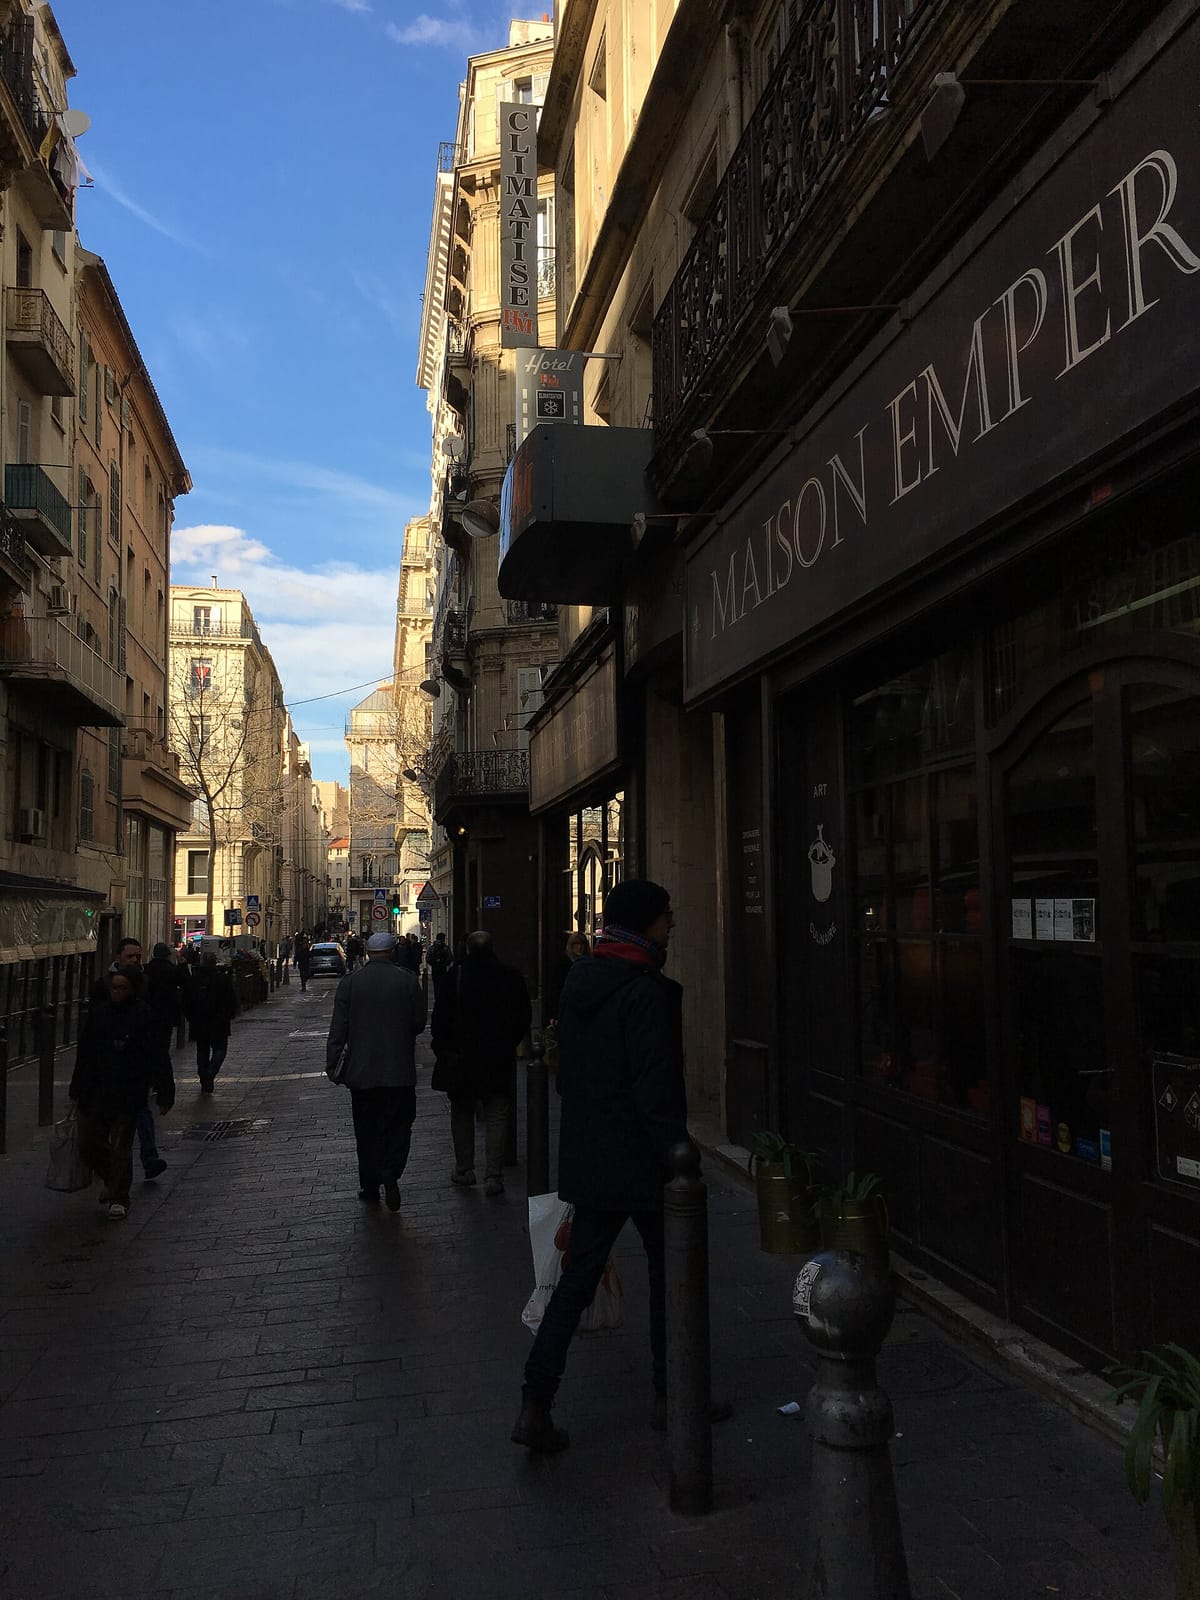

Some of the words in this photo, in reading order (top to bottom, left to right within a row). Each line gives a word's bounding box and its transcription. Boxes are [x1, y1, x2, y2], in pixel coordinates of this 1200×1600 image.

[505, 112, 533, 306] CLIMATISE
[524, 352, 575, 375] Hotel
[710, 424, 869, 640] MAISON
[884, 149, 1200, 505] EMPER
[813, 783, 828, 799] ART
